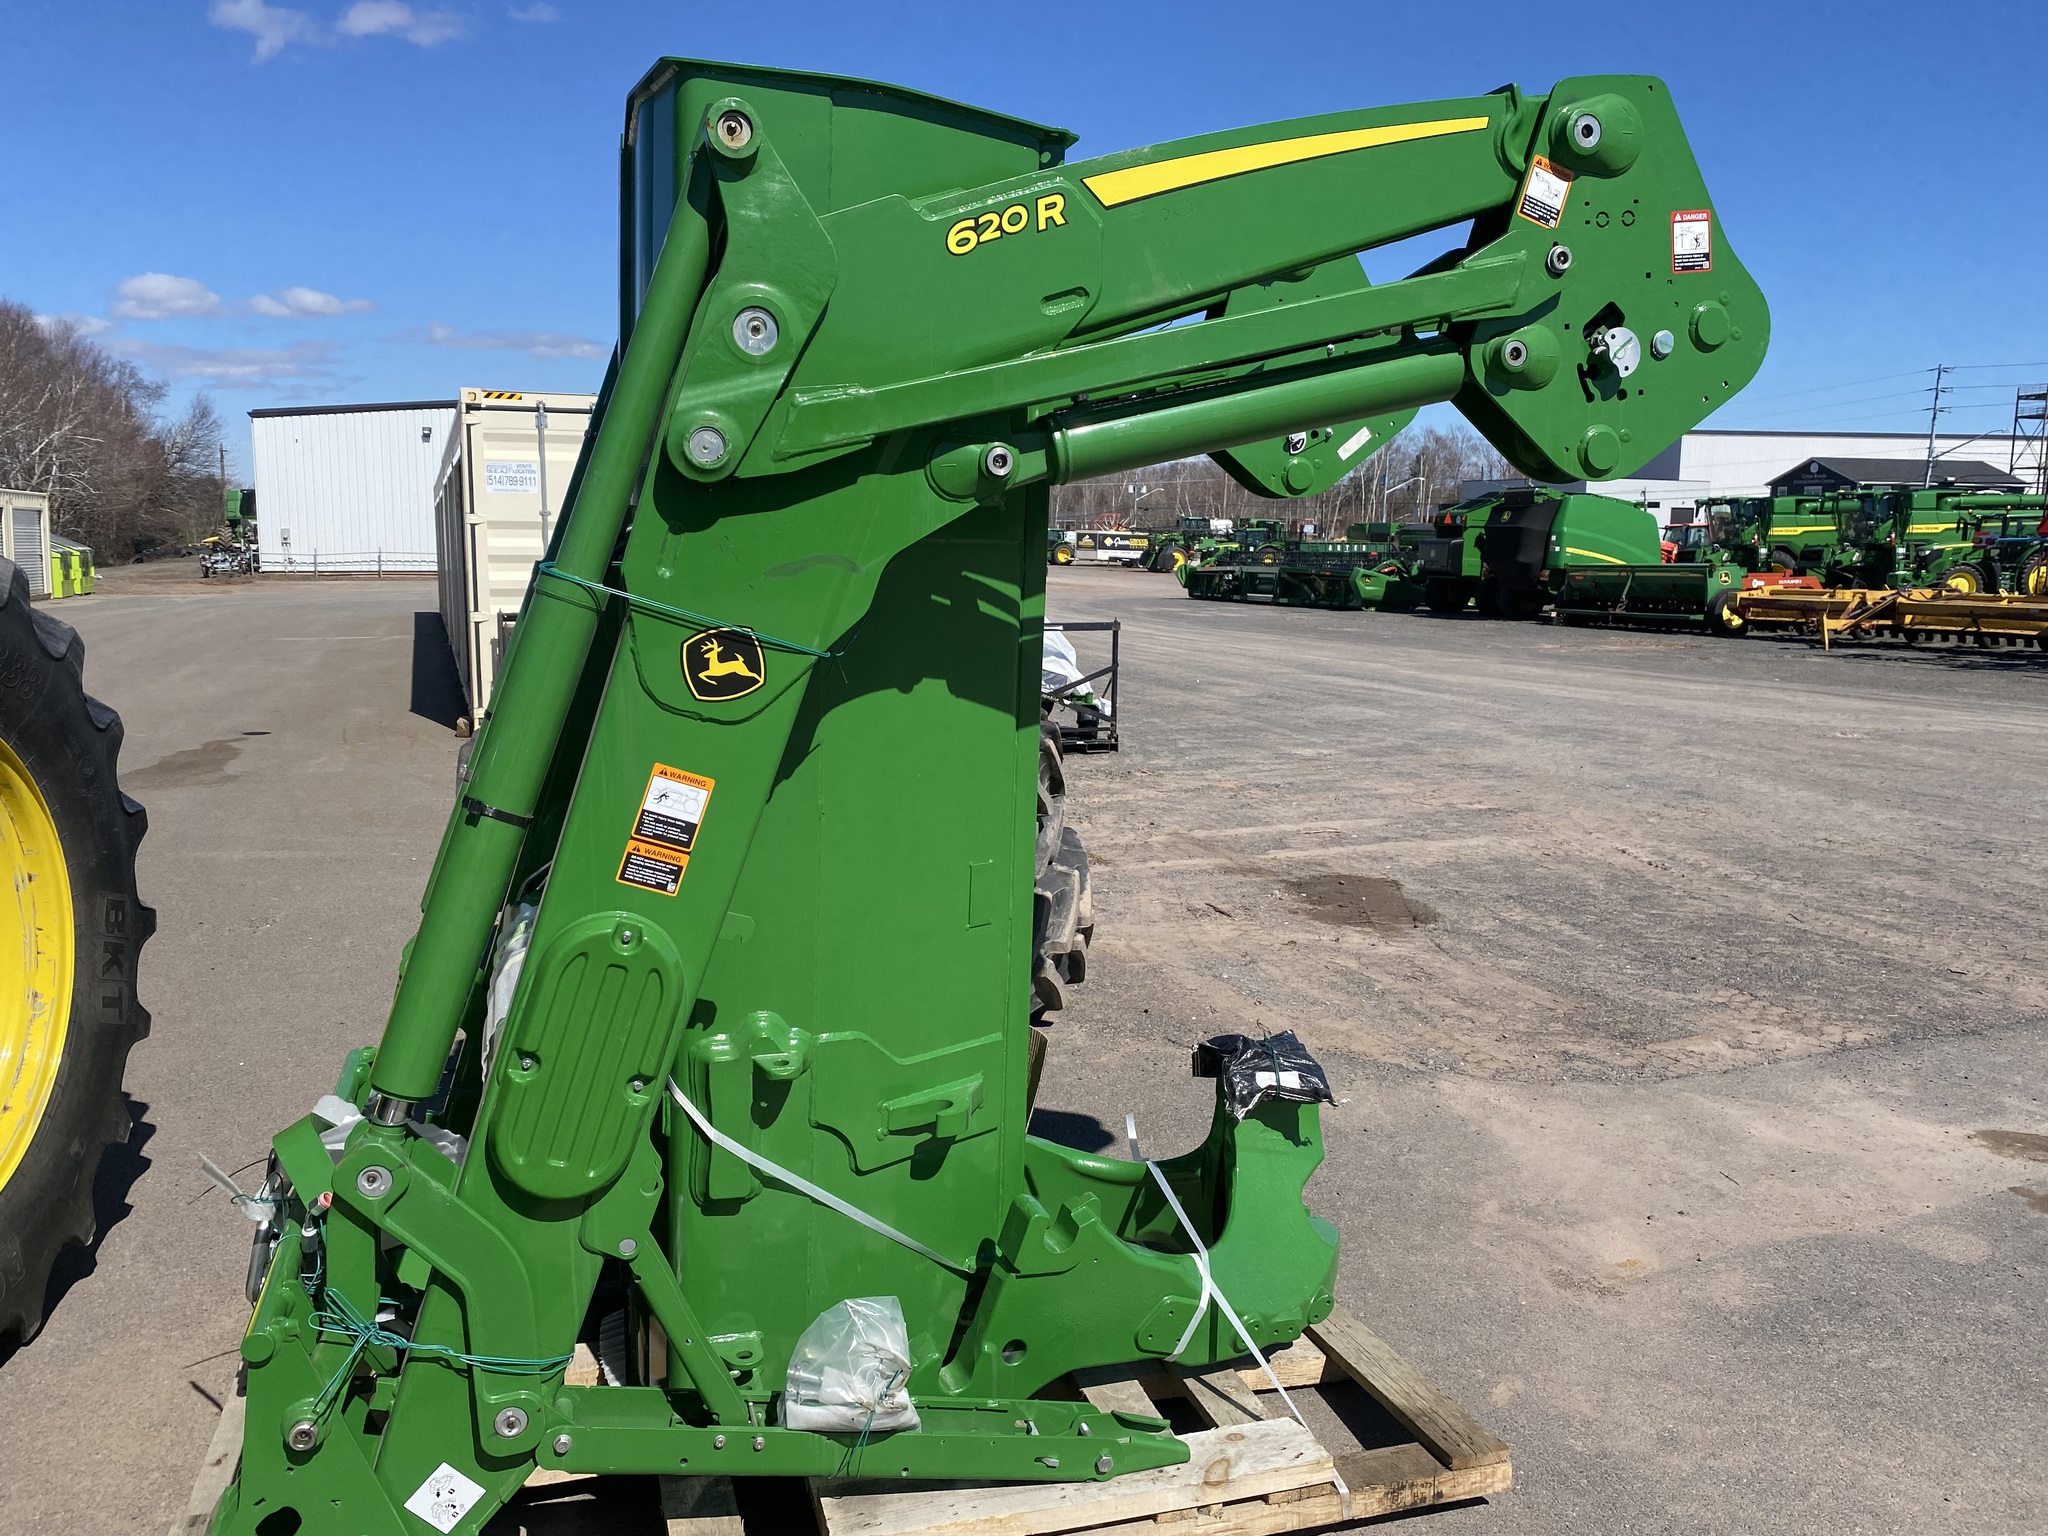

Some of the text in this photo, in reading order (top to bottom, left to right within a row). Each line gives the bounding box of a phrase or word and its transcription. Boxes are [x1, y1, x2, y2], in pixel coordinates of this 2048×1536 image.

[1543, 161, 1572, 180] WARNING
[945, 191, 1070, 257] 620 R
[1682, 212, 1708, 220] DANGER
[669, 771, 707, 787] WARNING
[644, 848, 681, 863] WARNING
[102, 898, 126, 1021] BKT
